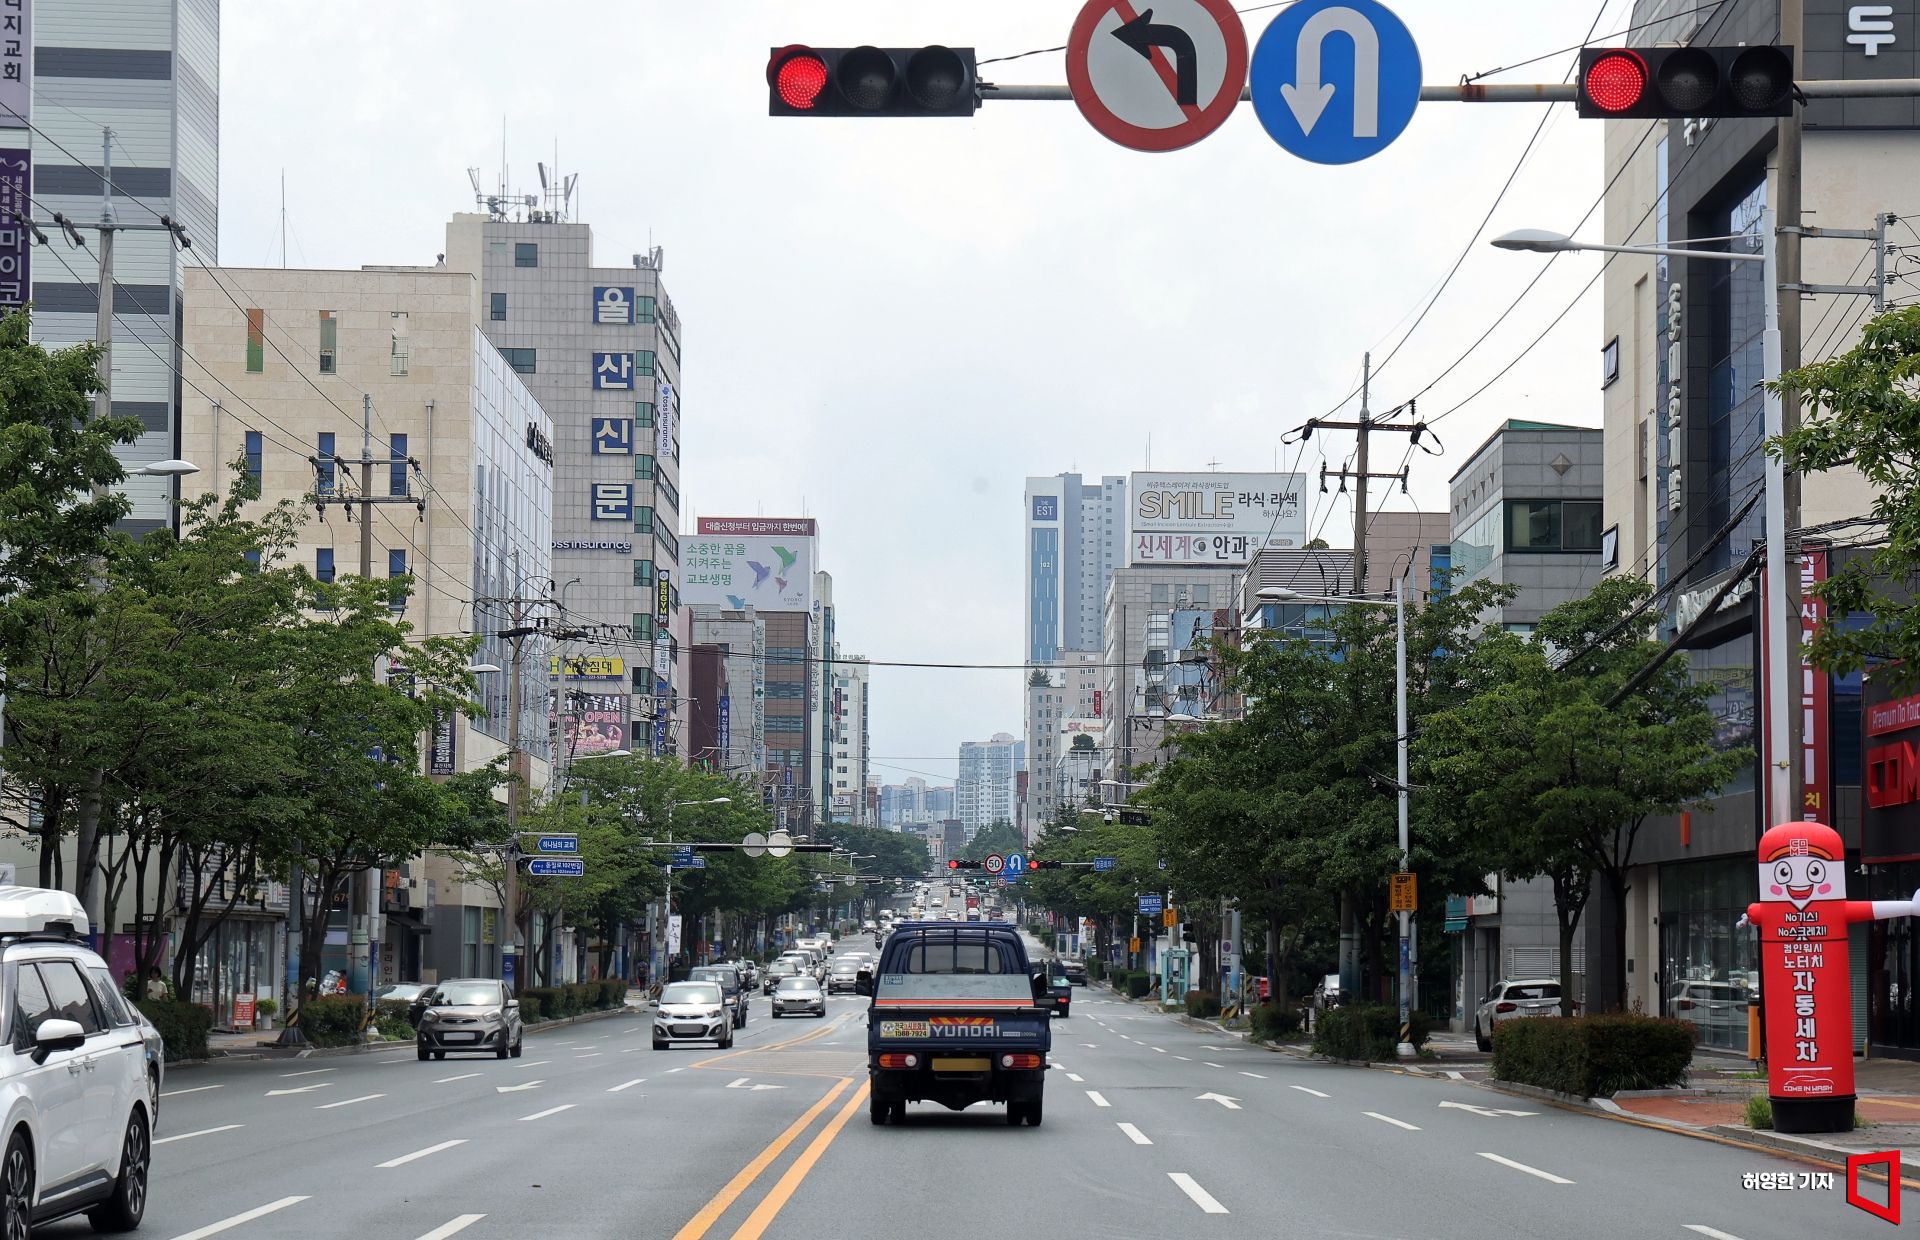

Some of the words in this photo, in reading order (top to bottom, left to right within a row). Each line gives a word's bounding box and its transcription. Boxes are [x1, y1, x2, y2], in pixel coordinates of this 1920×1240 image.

[596, 287, 632, 519] 울산신문
[662, 395, 671, 410] toss
[662, 412, 671, 448] insurance
[1139, 490, 1235, 520] SMILE
[1239, 492, 1298, 508] 라식·라섹
[1036, 506, 1054, 516] EST
[1262, 509, 1298, 518] 하시나요?
[705, 522, 750, 531] 대출신청부터
[751, 522, 781, 531] 입금까지
[570, 539, 631, 550] insurance
[686, 543, 721, 555] 소중한
[723, 543, 746, 555] 꿈을
[1138, 535, 1191, 560] 신세계
[1213, 535, 1249, 560] 안과
[686, 558, 732, 570] 지켜주는
[686, 573, 732, 586] 교보생명
[584, 711, 620, 723] OPEN
[1897, 703, 1905, 723] No
[542, 840, 563, 849] 하나님의
[564, 841, 575, 849] 교회
[988, 859, 1000, 868] 50
[1785, 912, 1818, 922] No기스!
[1784, 944, 1823, 954] 컴인워시
[1784, 955, 1824, 968] 노터치
[1793, 971, 1818, 1062] 자동세차
[928, 1025, 999, 1037] YUNDAI
